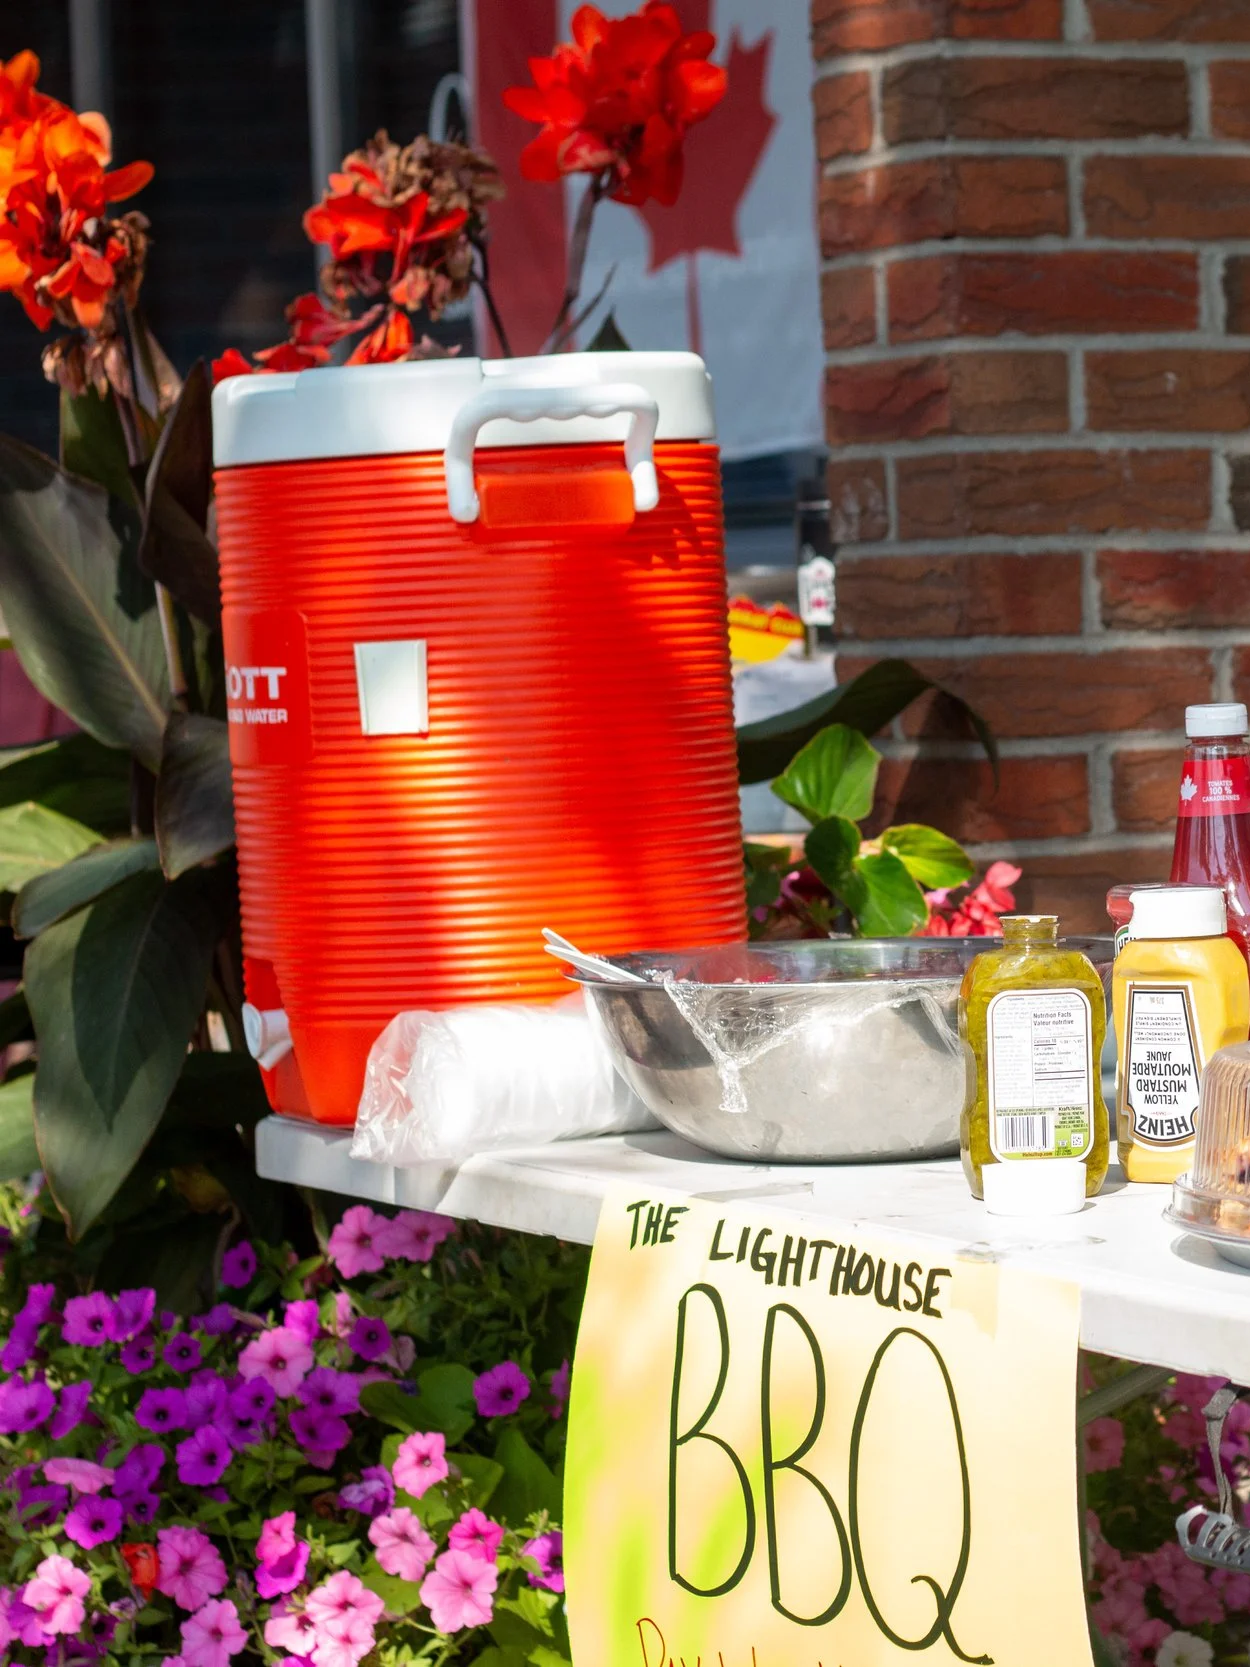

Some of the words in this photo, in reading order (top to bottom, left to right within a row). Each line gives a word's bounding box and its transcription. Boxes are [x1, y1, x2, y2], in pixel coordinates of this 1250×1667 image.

[226, 666, 287, 700] OTT
[245, 708, 288, 724] WATER
[1207, 779, 1233, 787] TOMATES
[1208, 787, 1223, 795] 100
[1202, 794, 1240, 803] CANADIENNES
[1146, 1051, 1172, 1061] JAUNE
[1132, 1062, 1191, 1076] MOUTARDE
[1136, 1079, 1187, 1093] MUSTARD
[1143, 1094, 1179, 1105] YELLOW
[1137, 1113, 1190, 1137] HEINZ
[626, 1200, 691, 1251] THE
[708, 1219, 953, 1319] LIGHTHOUSE
[668, 1283, 995, 1666] BBQ
